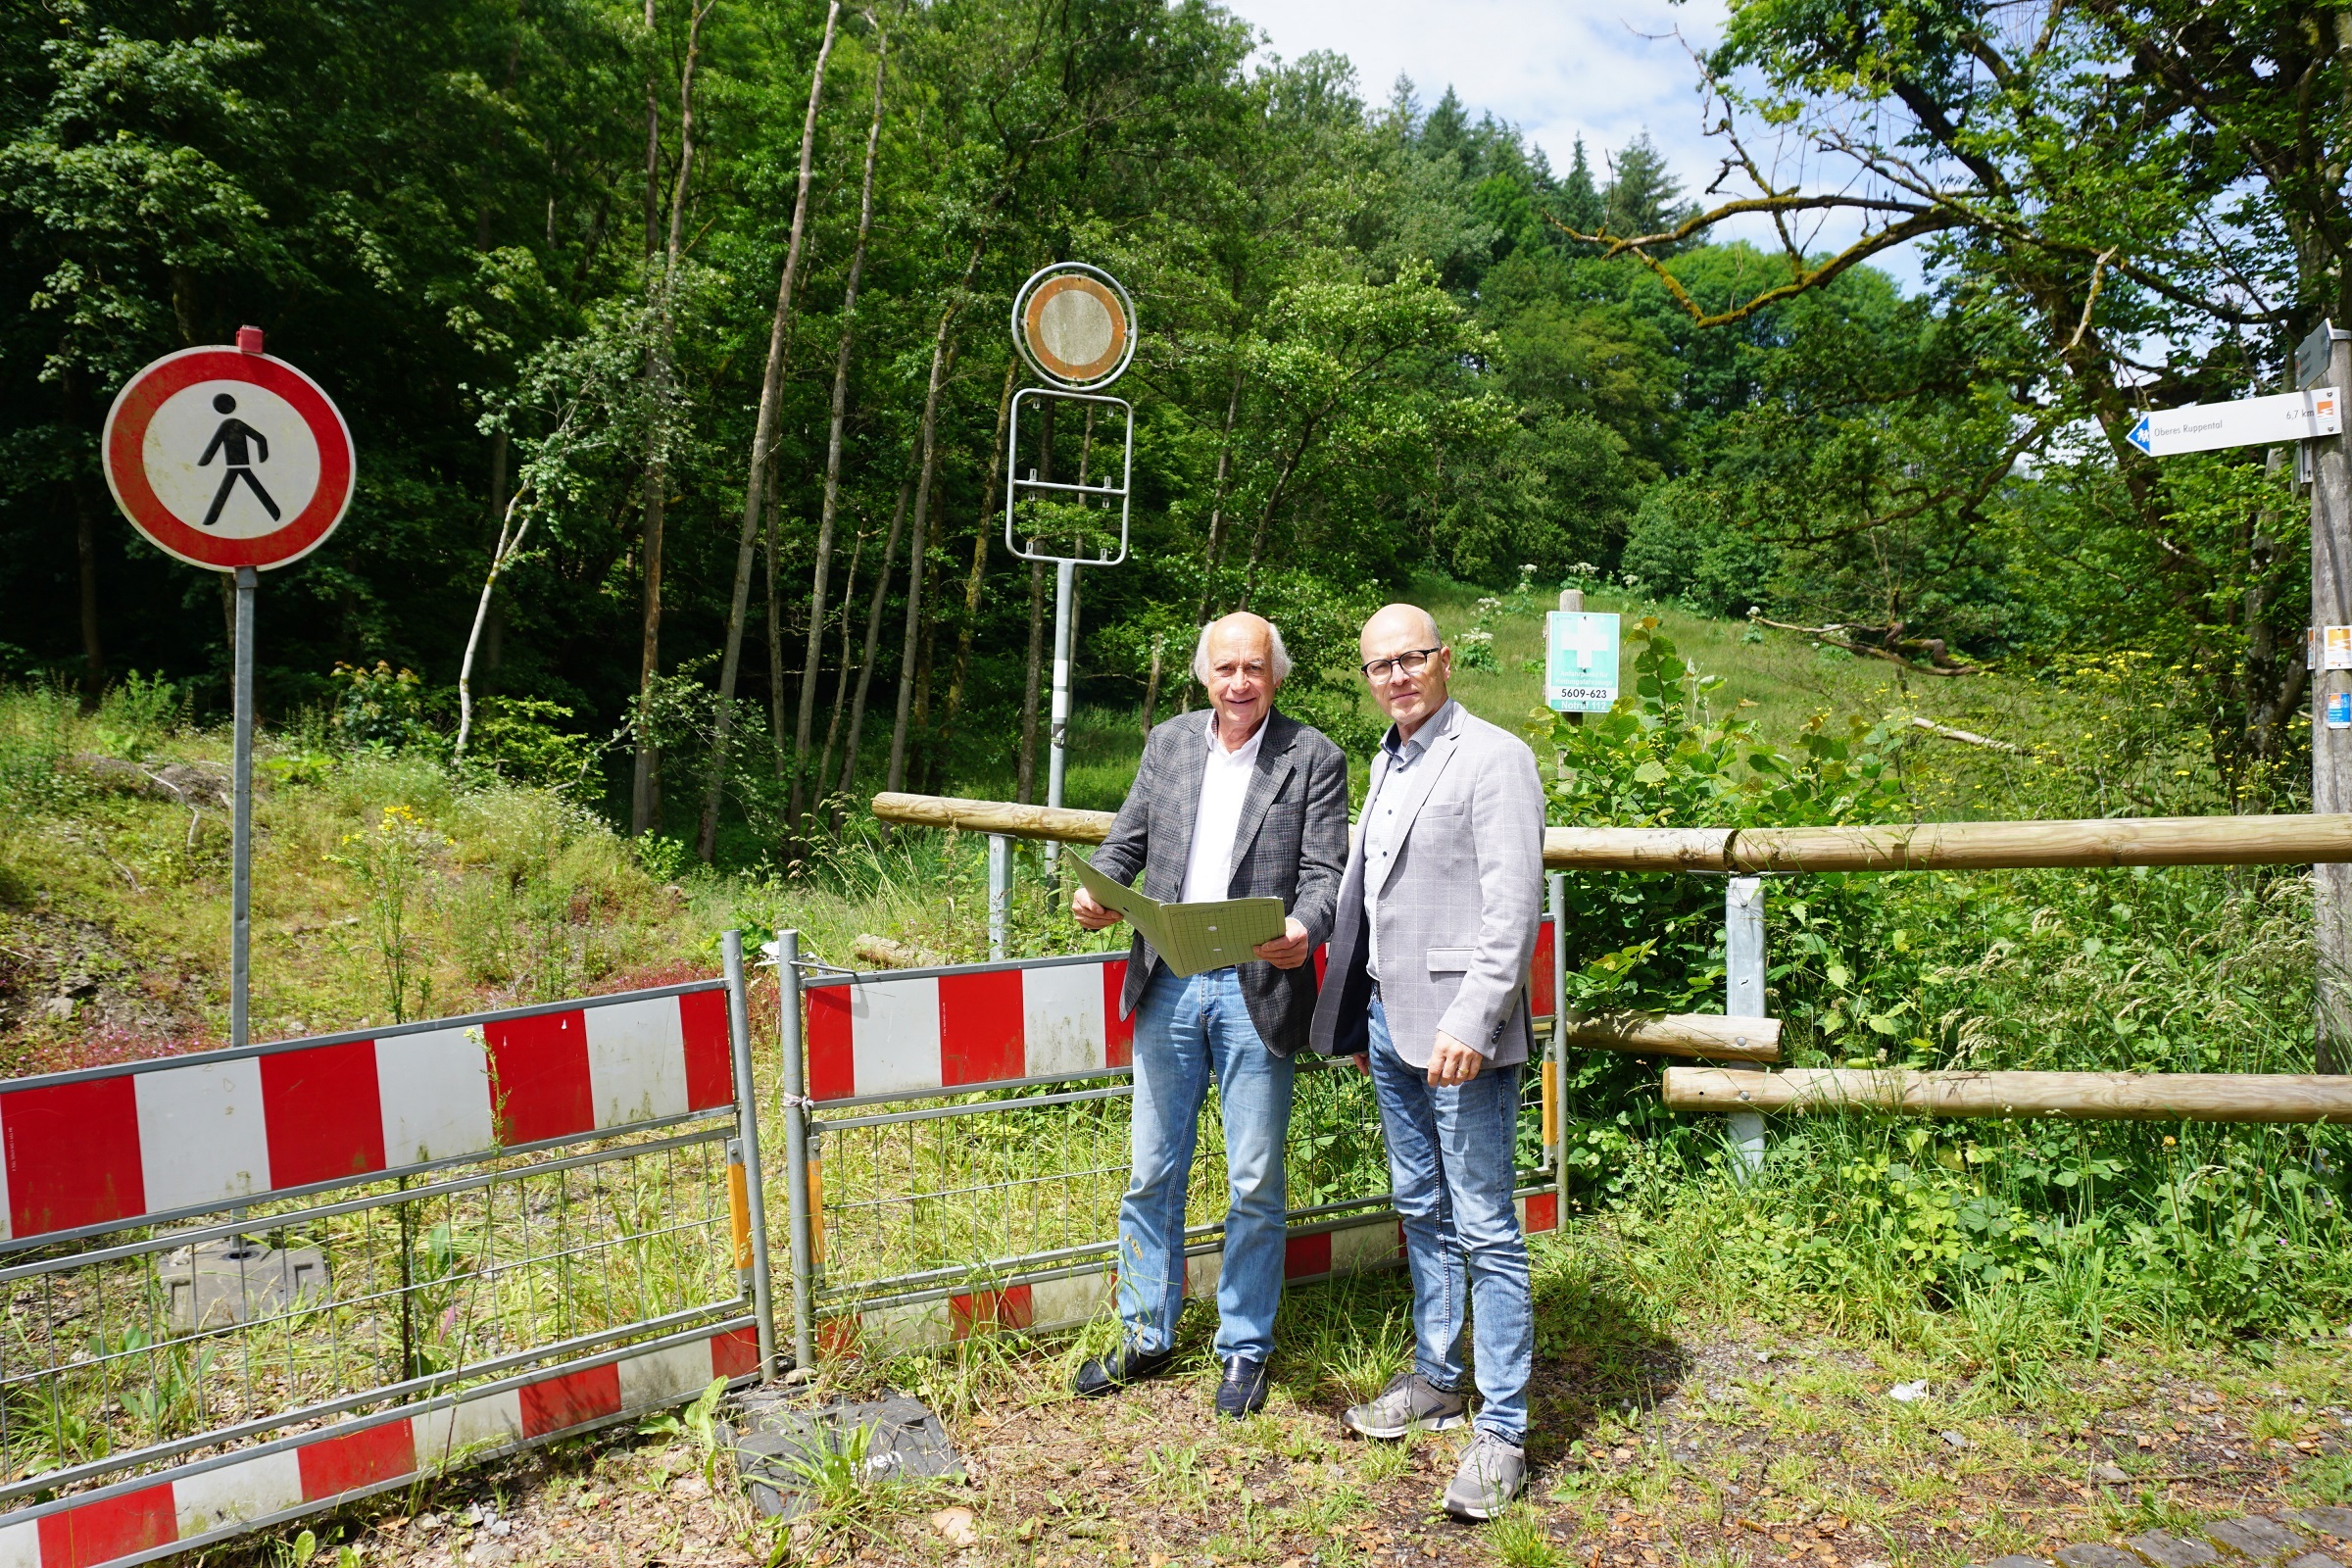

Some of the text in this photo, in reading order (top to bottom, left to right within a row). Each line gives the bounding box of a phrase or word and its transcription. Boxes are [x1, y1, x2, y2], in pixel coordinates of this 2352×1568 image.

[2286, 408, 2315, 420] 6,7 km
[2154, 419, 2223, 437] Oberes Ruppental
[1561, 688, 1607, 699] 5609-623
[1561, 700, 1606, 710] Notruf 112
